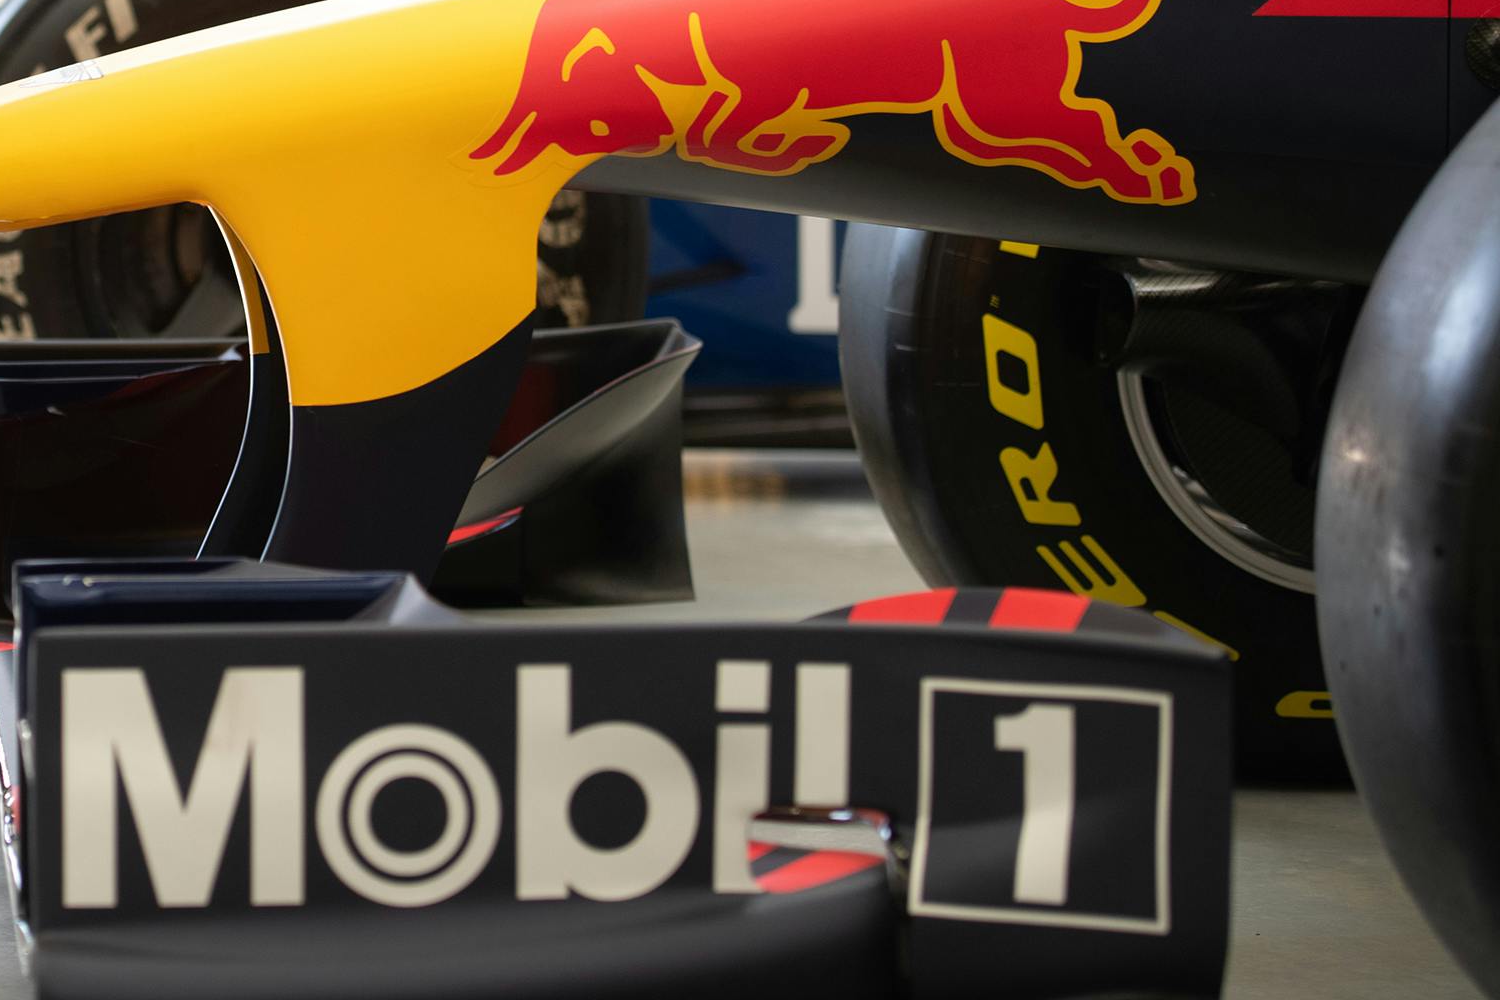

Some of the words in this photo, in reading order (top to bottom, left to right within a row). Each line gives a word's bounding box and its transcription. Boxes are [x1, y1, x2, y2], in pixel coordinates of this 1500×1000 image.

[983, 312, 1240, 662] ERO
[61, 659, 851, 909] Mobil
[993, 702, 1075, 906] 1
